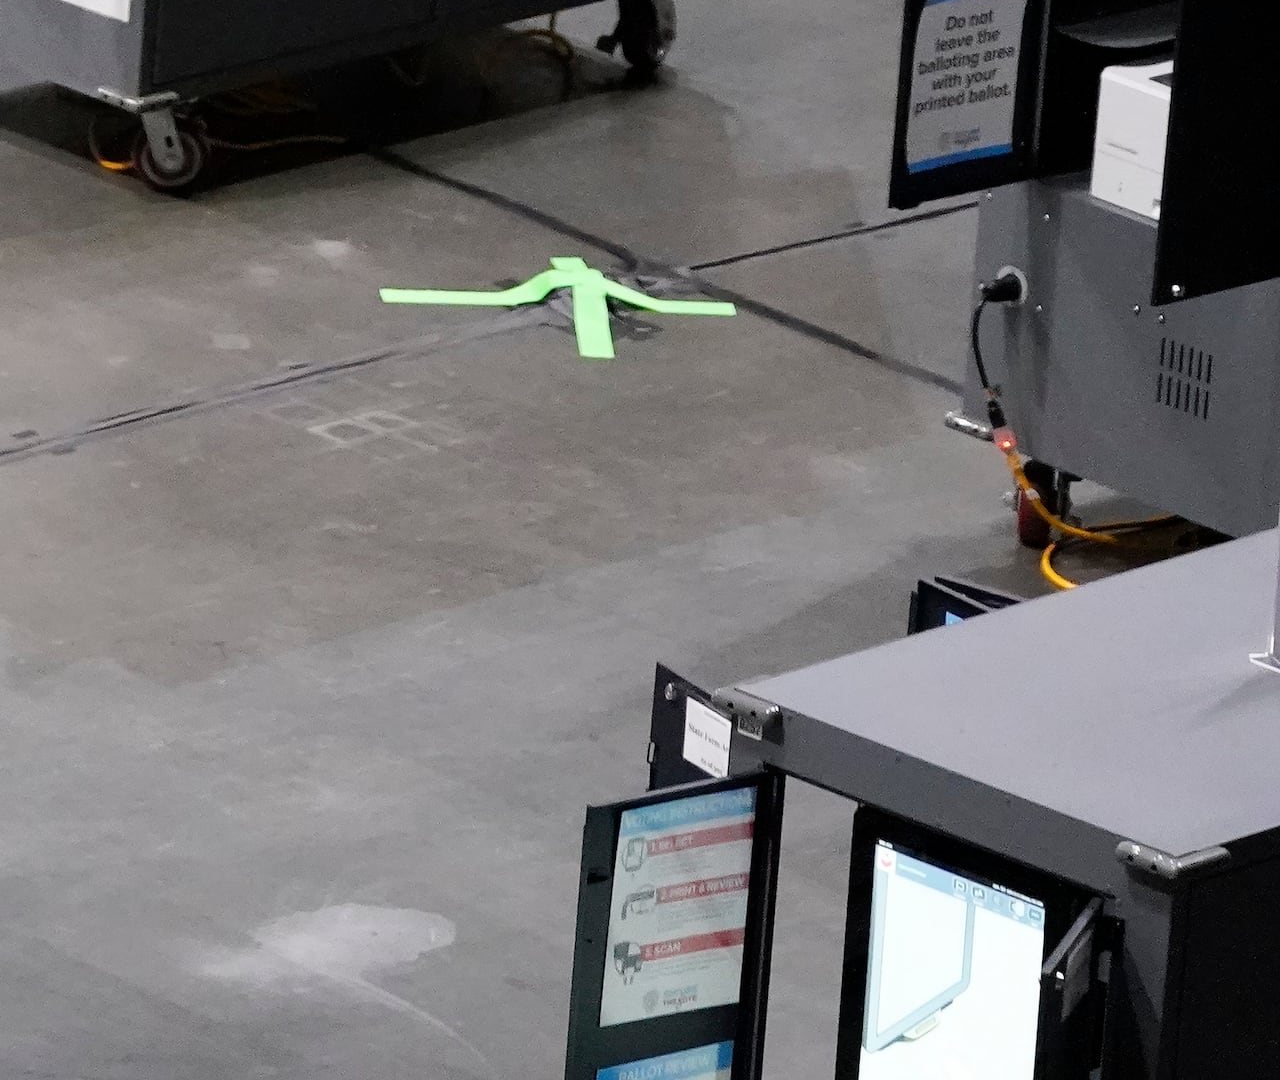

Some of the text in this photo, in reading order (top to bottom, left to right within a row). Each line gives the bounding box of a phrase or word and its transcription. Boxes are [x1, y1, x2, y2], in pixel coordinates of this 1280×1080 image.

[945, 9, 994, 32] Do not
[935, 29, 1000, 53] leave the
[917, 45, 1016, 75] balloting area
[931, 68, 997, 91] with your
[914, 91, 965, 117] printed
[654, 941, 681, 957] SCAN
[618, 1062, 662, 1080] BALLOT
